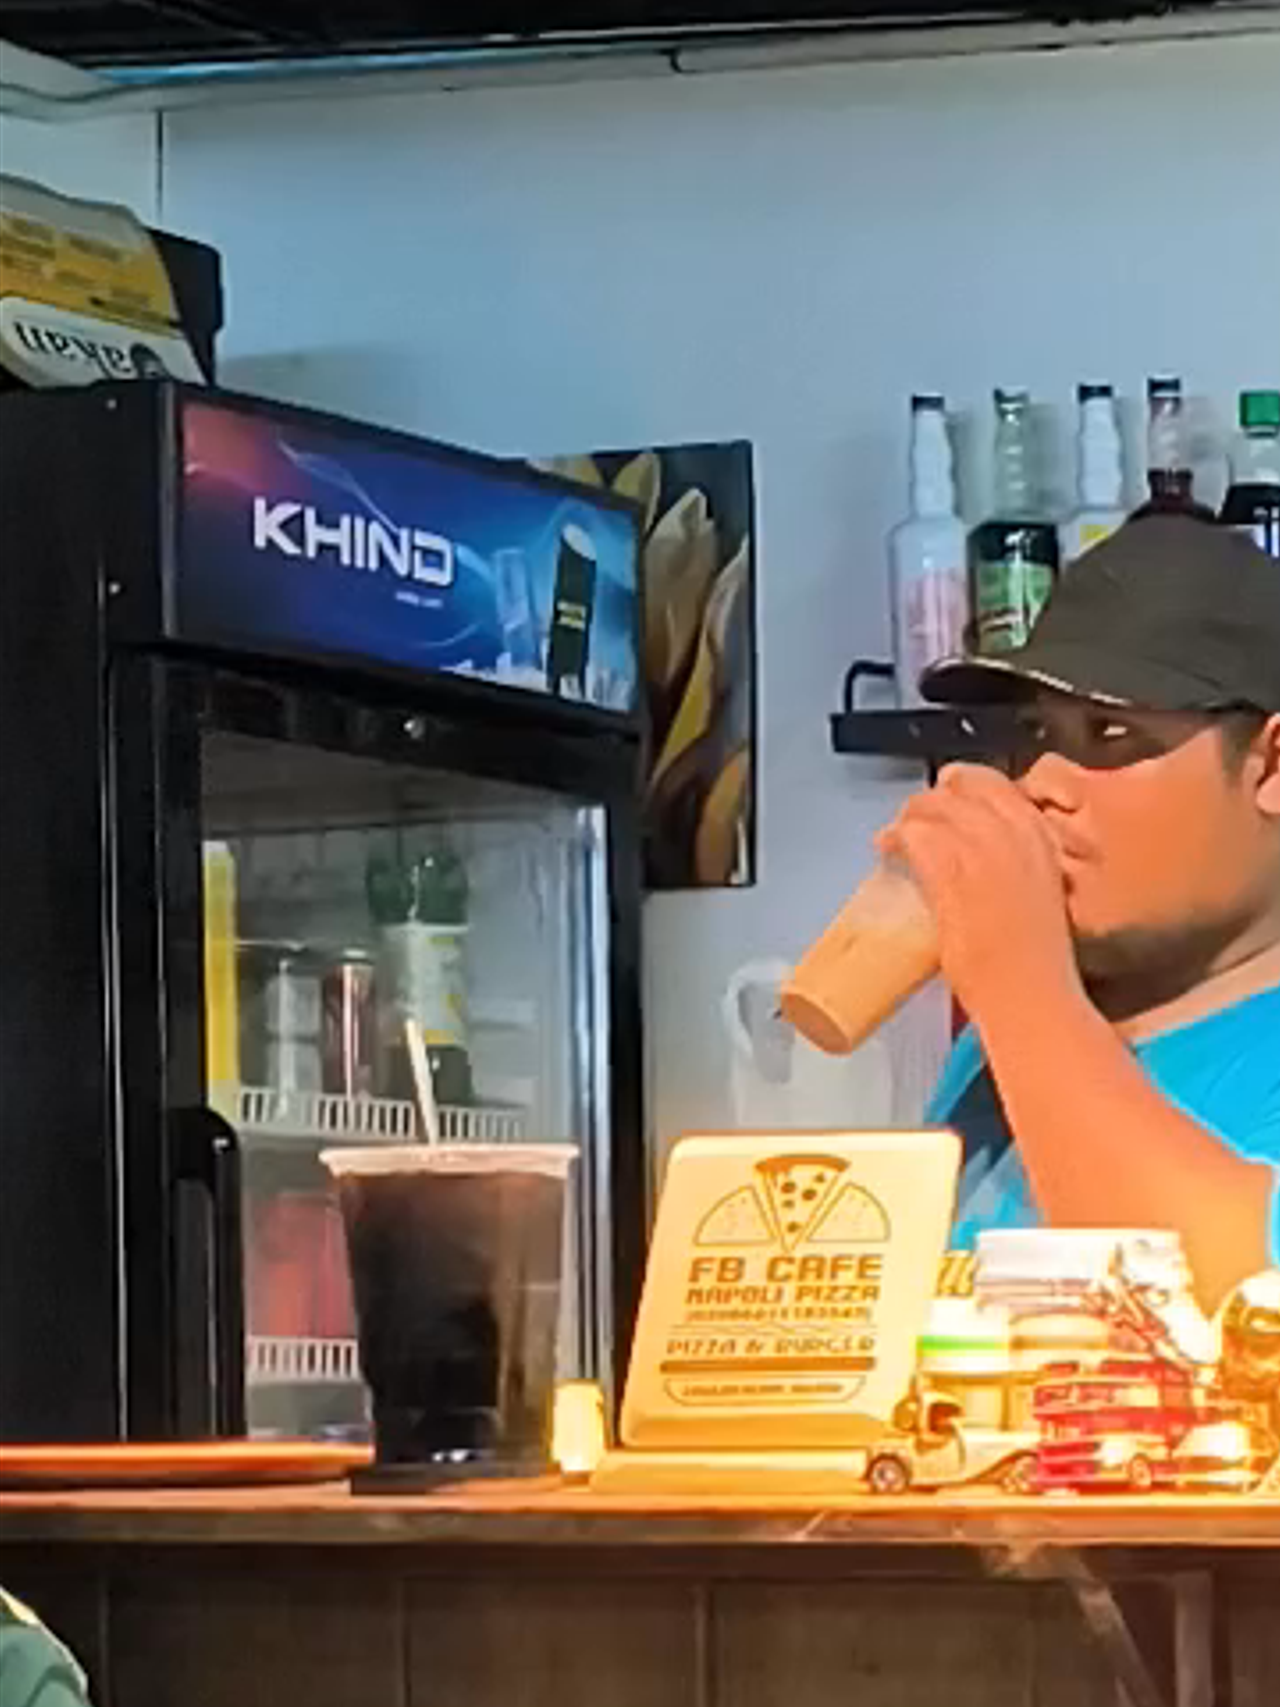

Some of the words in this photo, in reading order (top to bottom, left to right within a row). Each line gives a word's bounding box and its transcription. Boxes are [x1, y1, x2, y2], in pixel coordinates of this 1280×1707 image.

[253, 496, 455, 588] KHIND
[688, 1256, 746, 1283] FB
[766, 1253, 883, 1283] CAFE
[685, 1285, 785, 1305] NAPOLI
[794, 1284, 881, 1302] PIZZA
